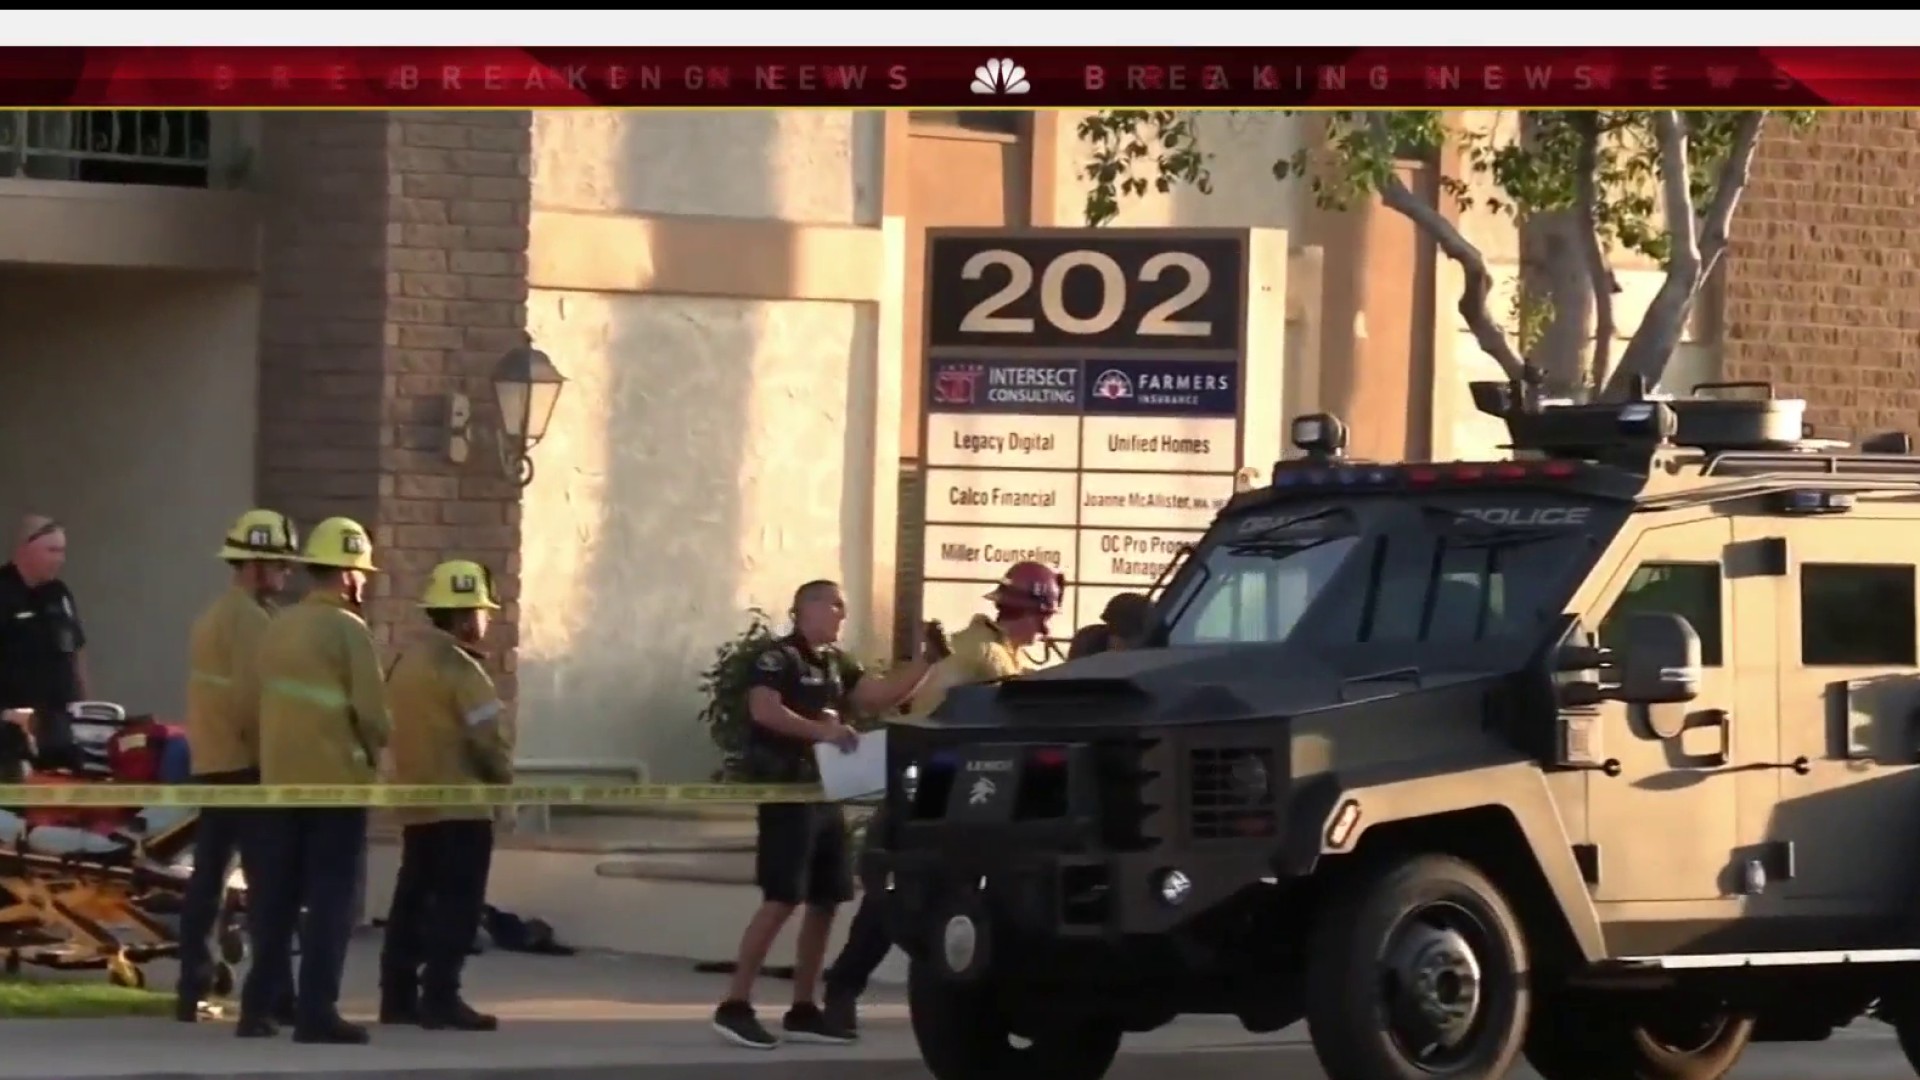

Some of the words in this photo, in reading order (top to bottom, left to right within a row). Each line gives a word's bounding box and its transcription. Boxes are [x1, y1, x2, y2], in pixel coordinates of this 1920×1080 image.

[958, 249, 1212, 337] 202
[988, 367, 1078, 386] INTERSECT
[1138, 374, 1229, 390] FARMERS
[987, 388, 1076, 403] CONSULTING
[1138, 395, 1200, 405] INSURANCE
[953, 431, 1004, 454] Legacy
[1009, 432, 1055, 455] Digital
[1108, 434, 1158, 452] Unified
[1161, 435, 1211, 454] Homes
[949, 486, 989, 507] Calco
[992, 487, 1056, 507] Financial
[1083, 491, 1126, 507] Joanne
[1453, 506, 1592, 526] POLICE
[1101, 535, 1120, 553] OC
[1124, 536, 1147, 554] Pro
[941, 543, 980, 562] Miller
[984, 546, 1061, 568] Counseling
